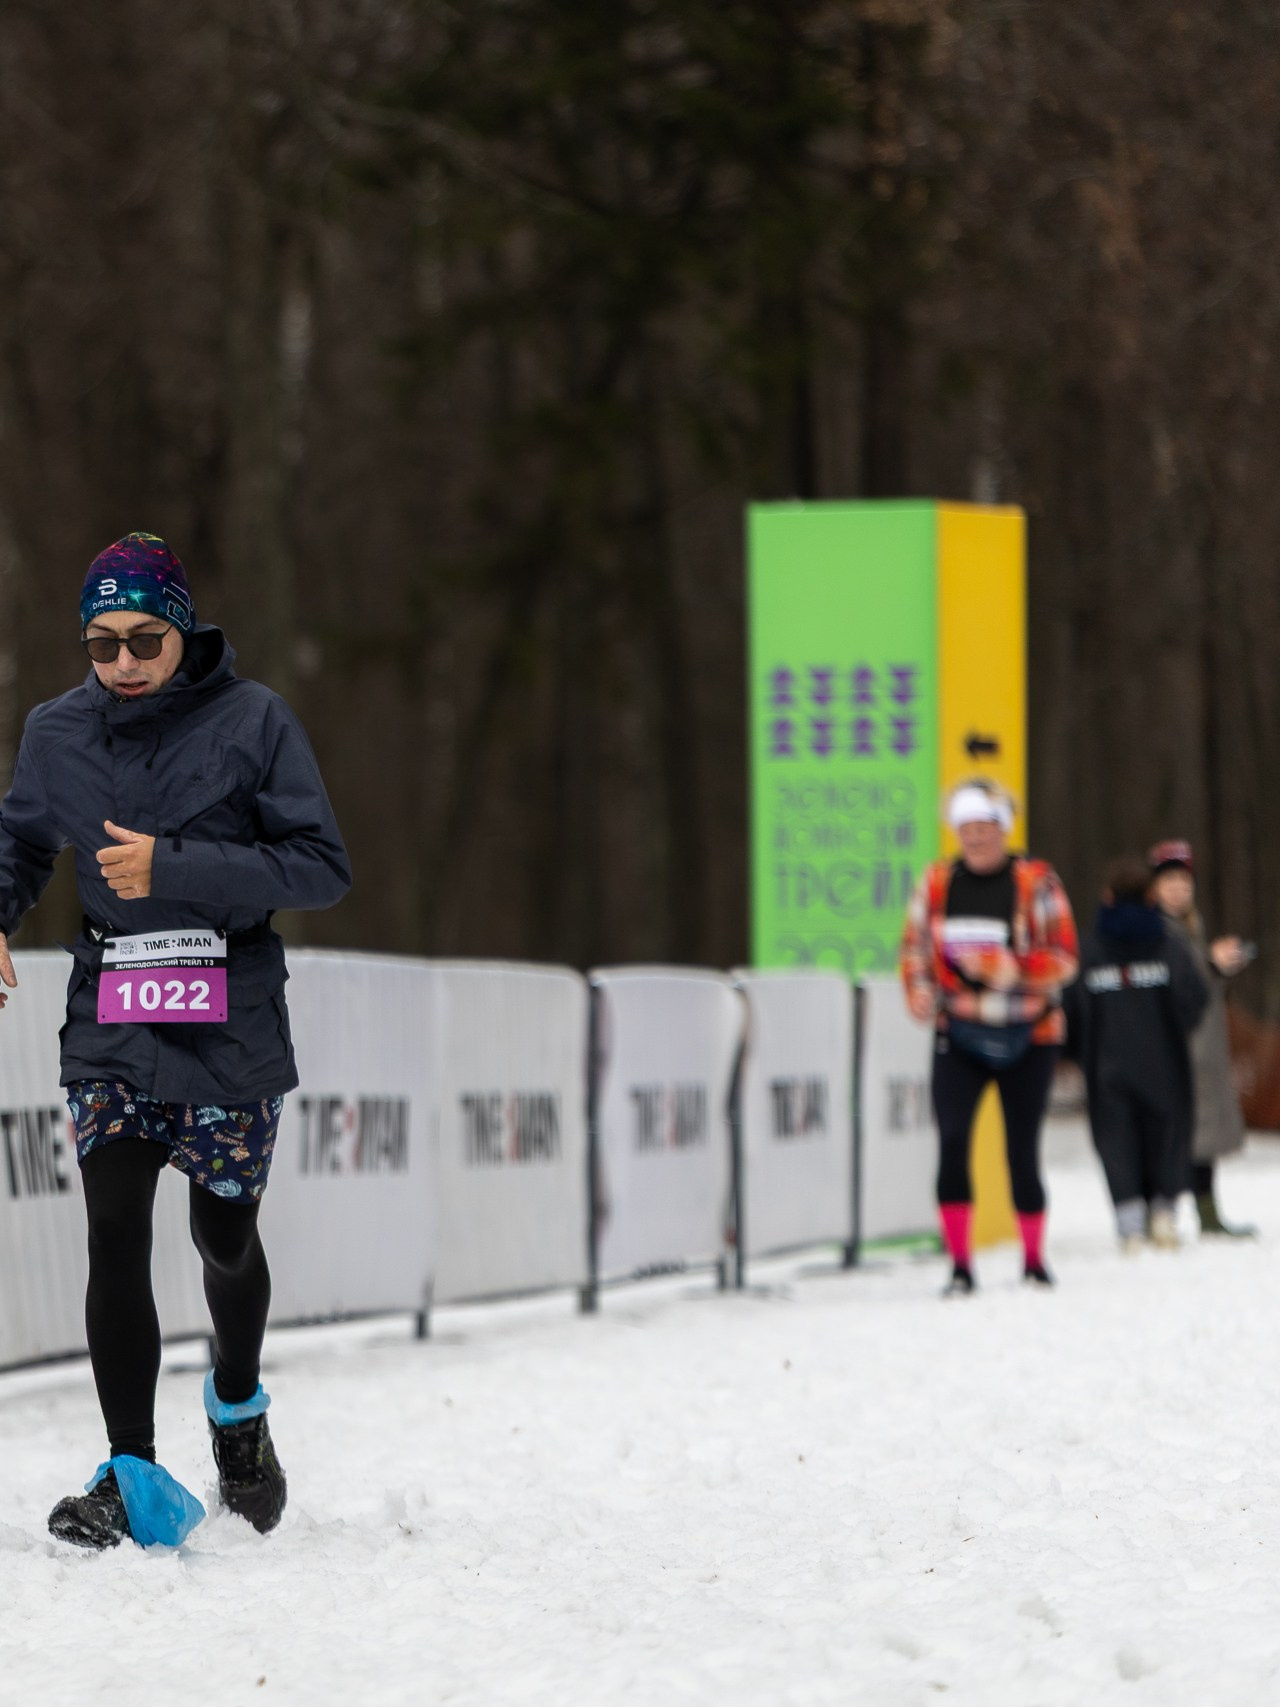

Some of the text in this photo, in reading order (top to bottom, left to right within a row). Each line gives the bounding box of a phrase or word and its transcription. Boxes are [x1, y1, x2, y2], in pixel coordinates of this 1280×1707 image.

[115, 958, 179, 970] ЗЕЛЕНОДОЛЬСКИЙ
[179, 957, 202, 966] ТРЕЙЛ
[117, 980, 210, 1010] 1022
